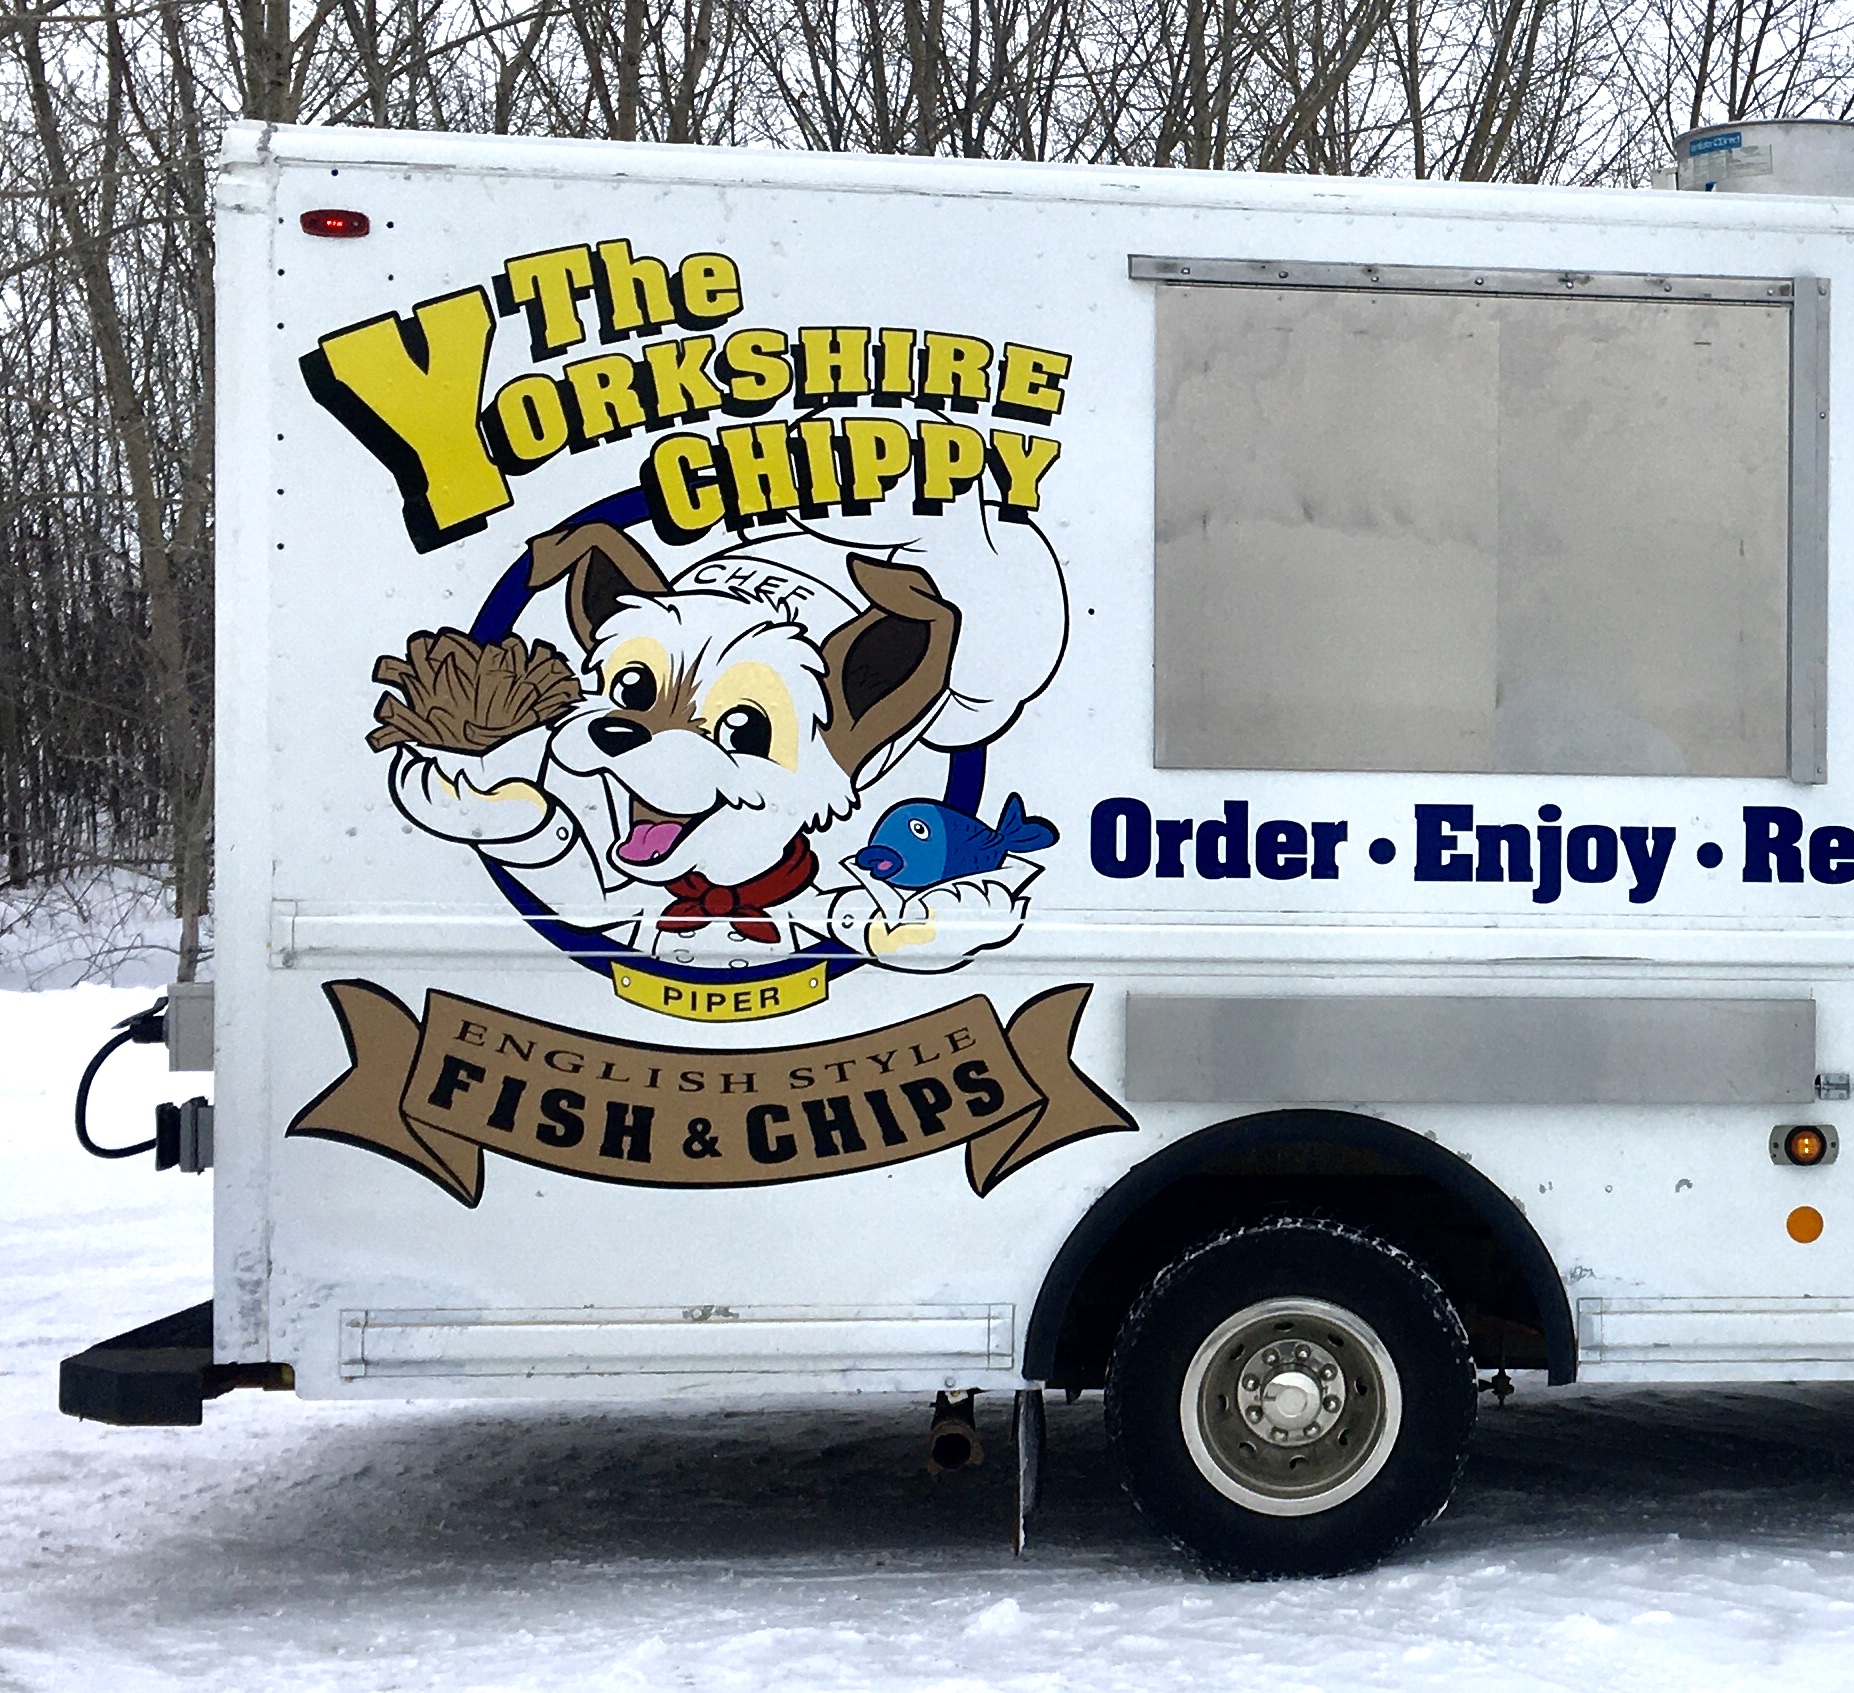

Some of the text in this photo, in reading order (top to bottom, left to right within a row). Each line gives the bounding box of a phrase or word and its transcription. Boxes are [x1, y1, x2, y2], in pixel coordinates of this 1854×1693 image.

[503, 239, 740, 352] The
[308, 287, 1071, 548] YORKSHIRE
[645, 417, 1061, 541] CHIPPY
[693, 563, 815, 604] CHEF
[1088, 794, 1348, 881] Order
[1413, 802, 1677, 905] Enjoy
[662, 984, 781, 1014] PIPER
[427, 1053, 1006, 1165] FISH & CHIPS
[451, 1018, 978, 1096] ENGLISH STYLE
